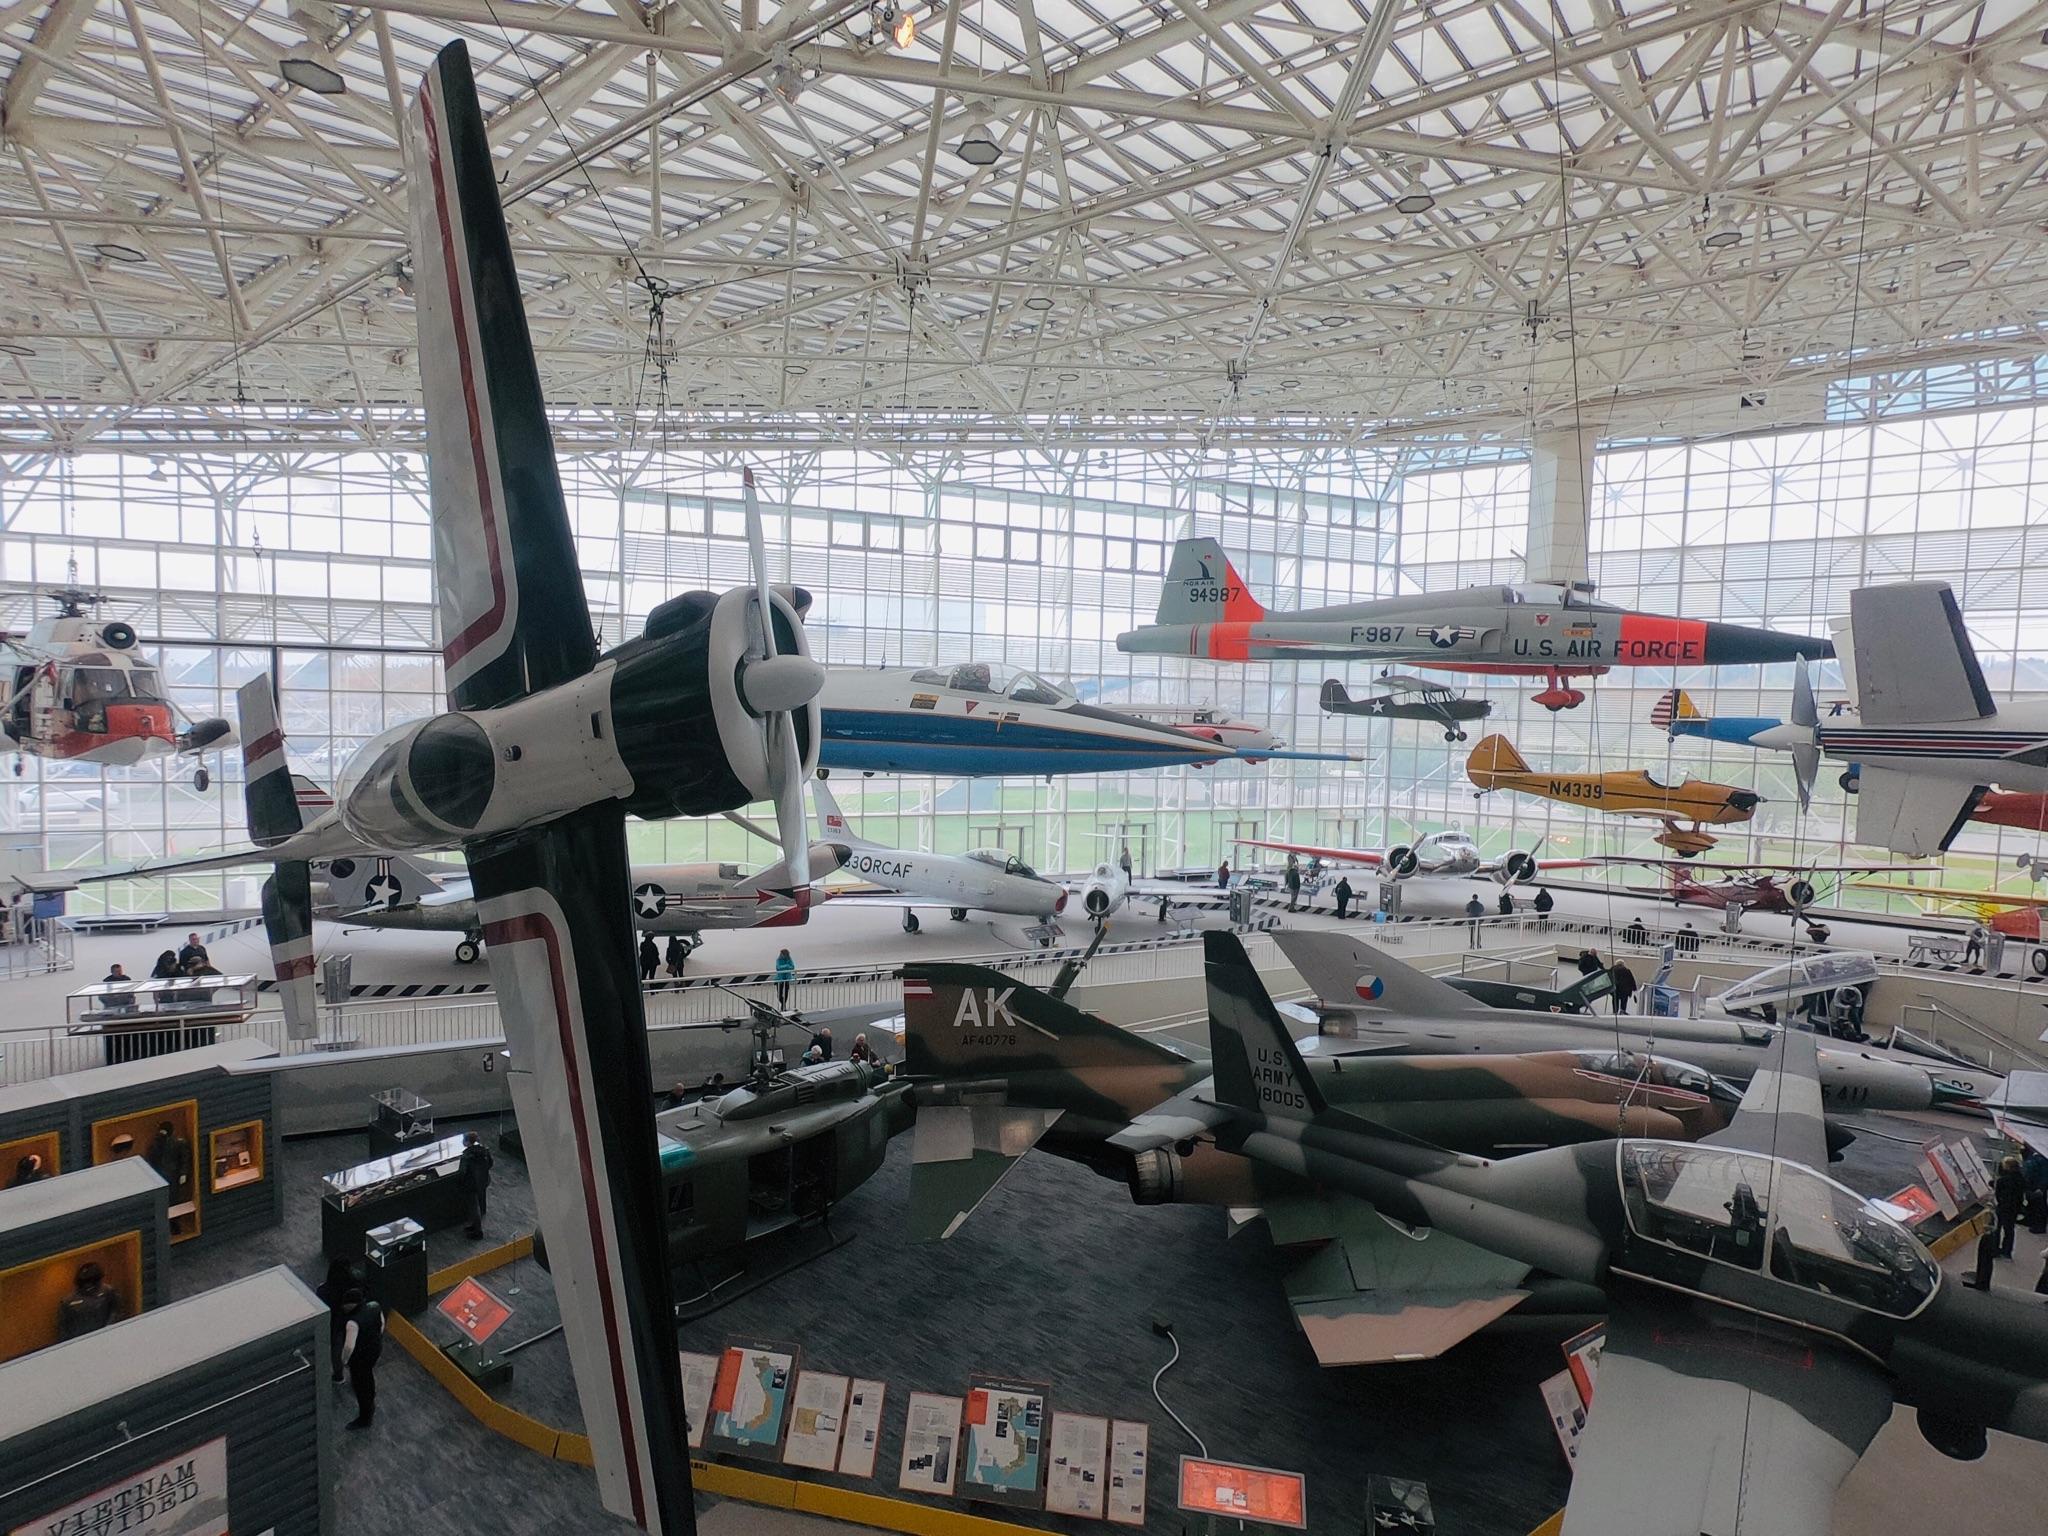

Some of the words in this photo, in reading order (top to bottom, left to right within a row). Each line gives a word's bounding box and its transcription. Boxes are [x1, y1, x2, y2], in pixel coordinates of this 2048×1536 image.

[1190, 587, 1240, 603] 94987
[1567, 639, 1601, 658] AIR
[1613, 640, 1699, 660] FORCE
[1549, 780, 1602, 800] N4339
[872, 859, 913, 879] RCAF
[952, 987, 1017, 1027] AK
[1257, 1047, 1288, 1068] U.S.
[1253, 1065, 1294, 1087] ARMY
[47, 1459, 196, 1536] VIETNAM
